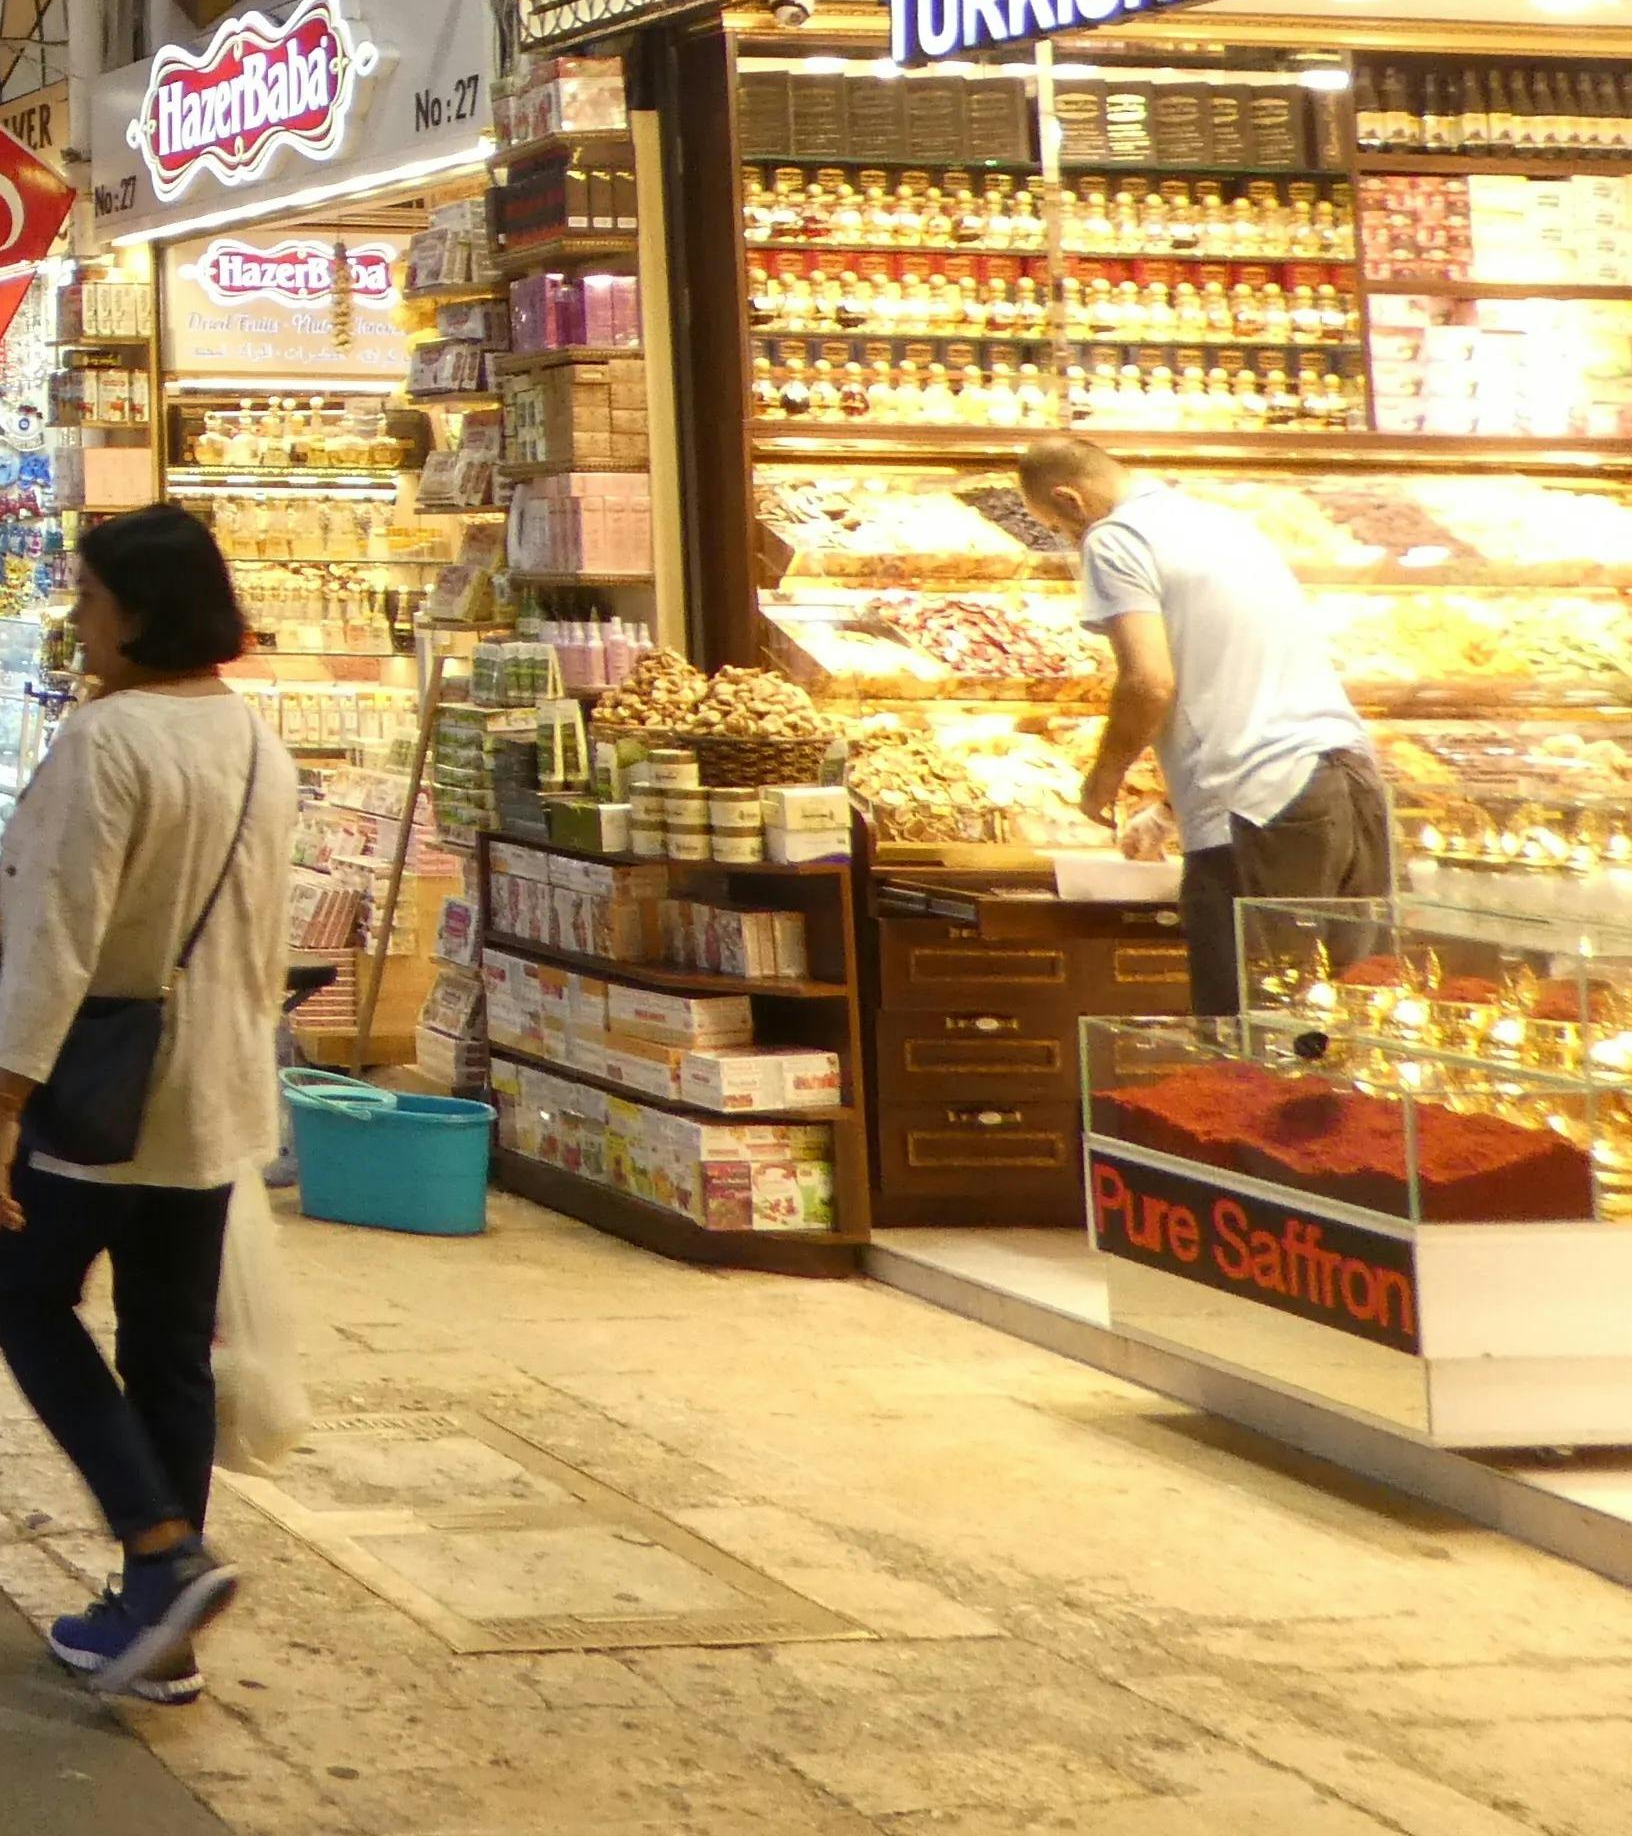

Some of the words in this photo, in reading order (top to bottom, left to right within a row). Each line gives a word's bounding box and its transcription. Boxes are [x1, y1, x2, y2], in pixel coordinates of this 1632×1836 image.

[158, 36, 332, 155] HazerBaba
[218, 254, 387, 290] HazerBba
[1093, 1162, 1200, 1262] Pure
[1212, 1198, 1414, 1335] Saffron
